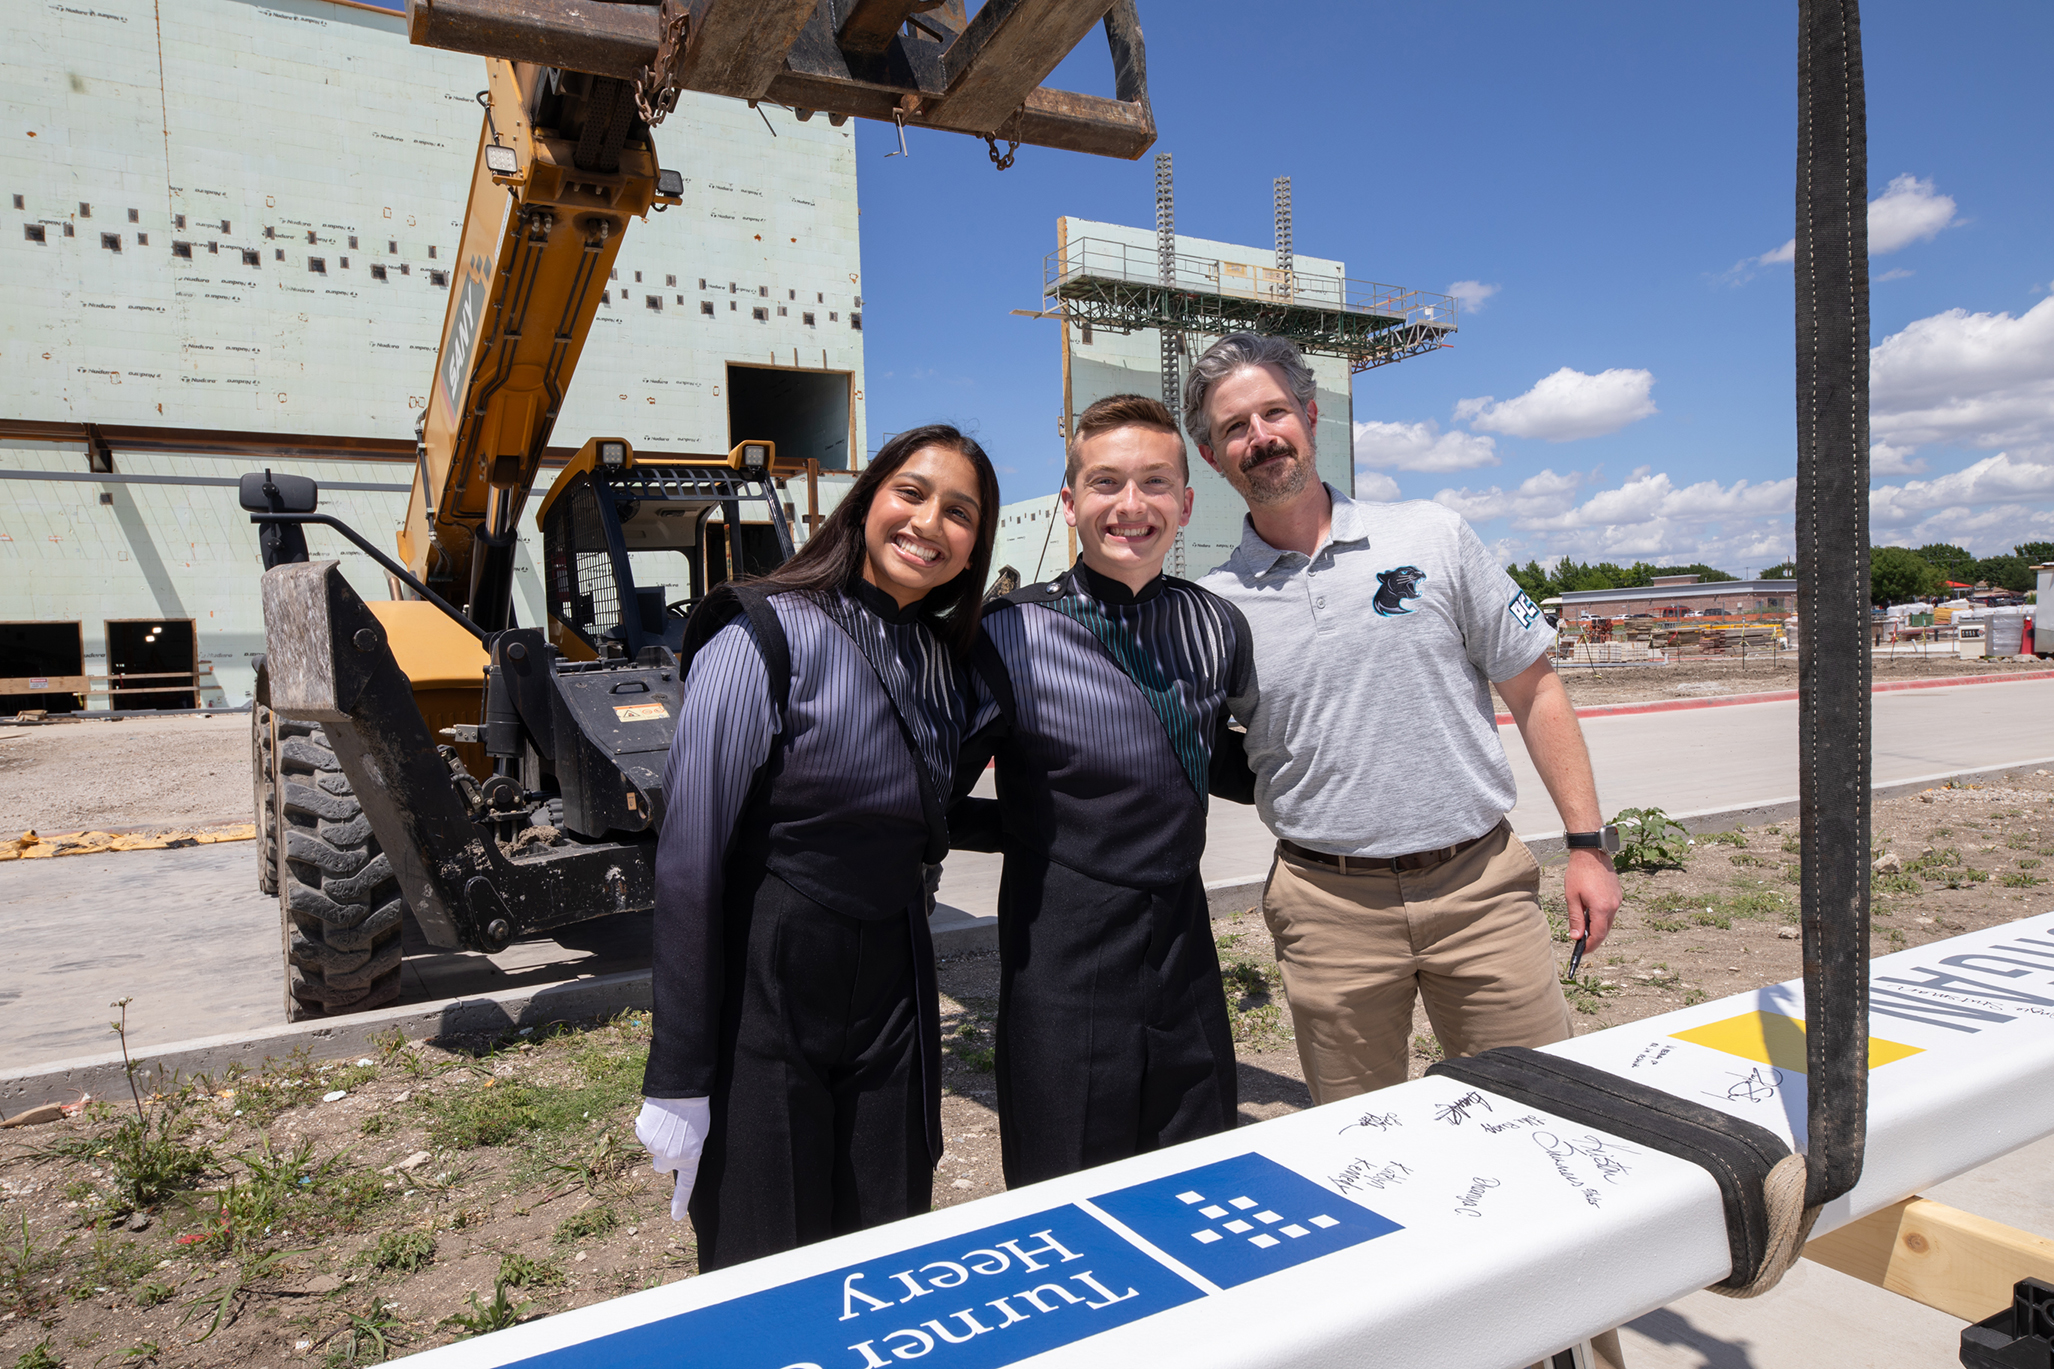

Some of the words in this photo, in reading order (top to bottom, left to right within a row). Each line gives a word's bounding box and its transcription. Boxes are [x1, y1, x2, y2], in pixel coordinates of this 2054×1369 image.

[448, 280, 474, 401] SANY
[838, 1229, 1084, 1321] Heery
[848, 1270, 1140, 1369] Turner
